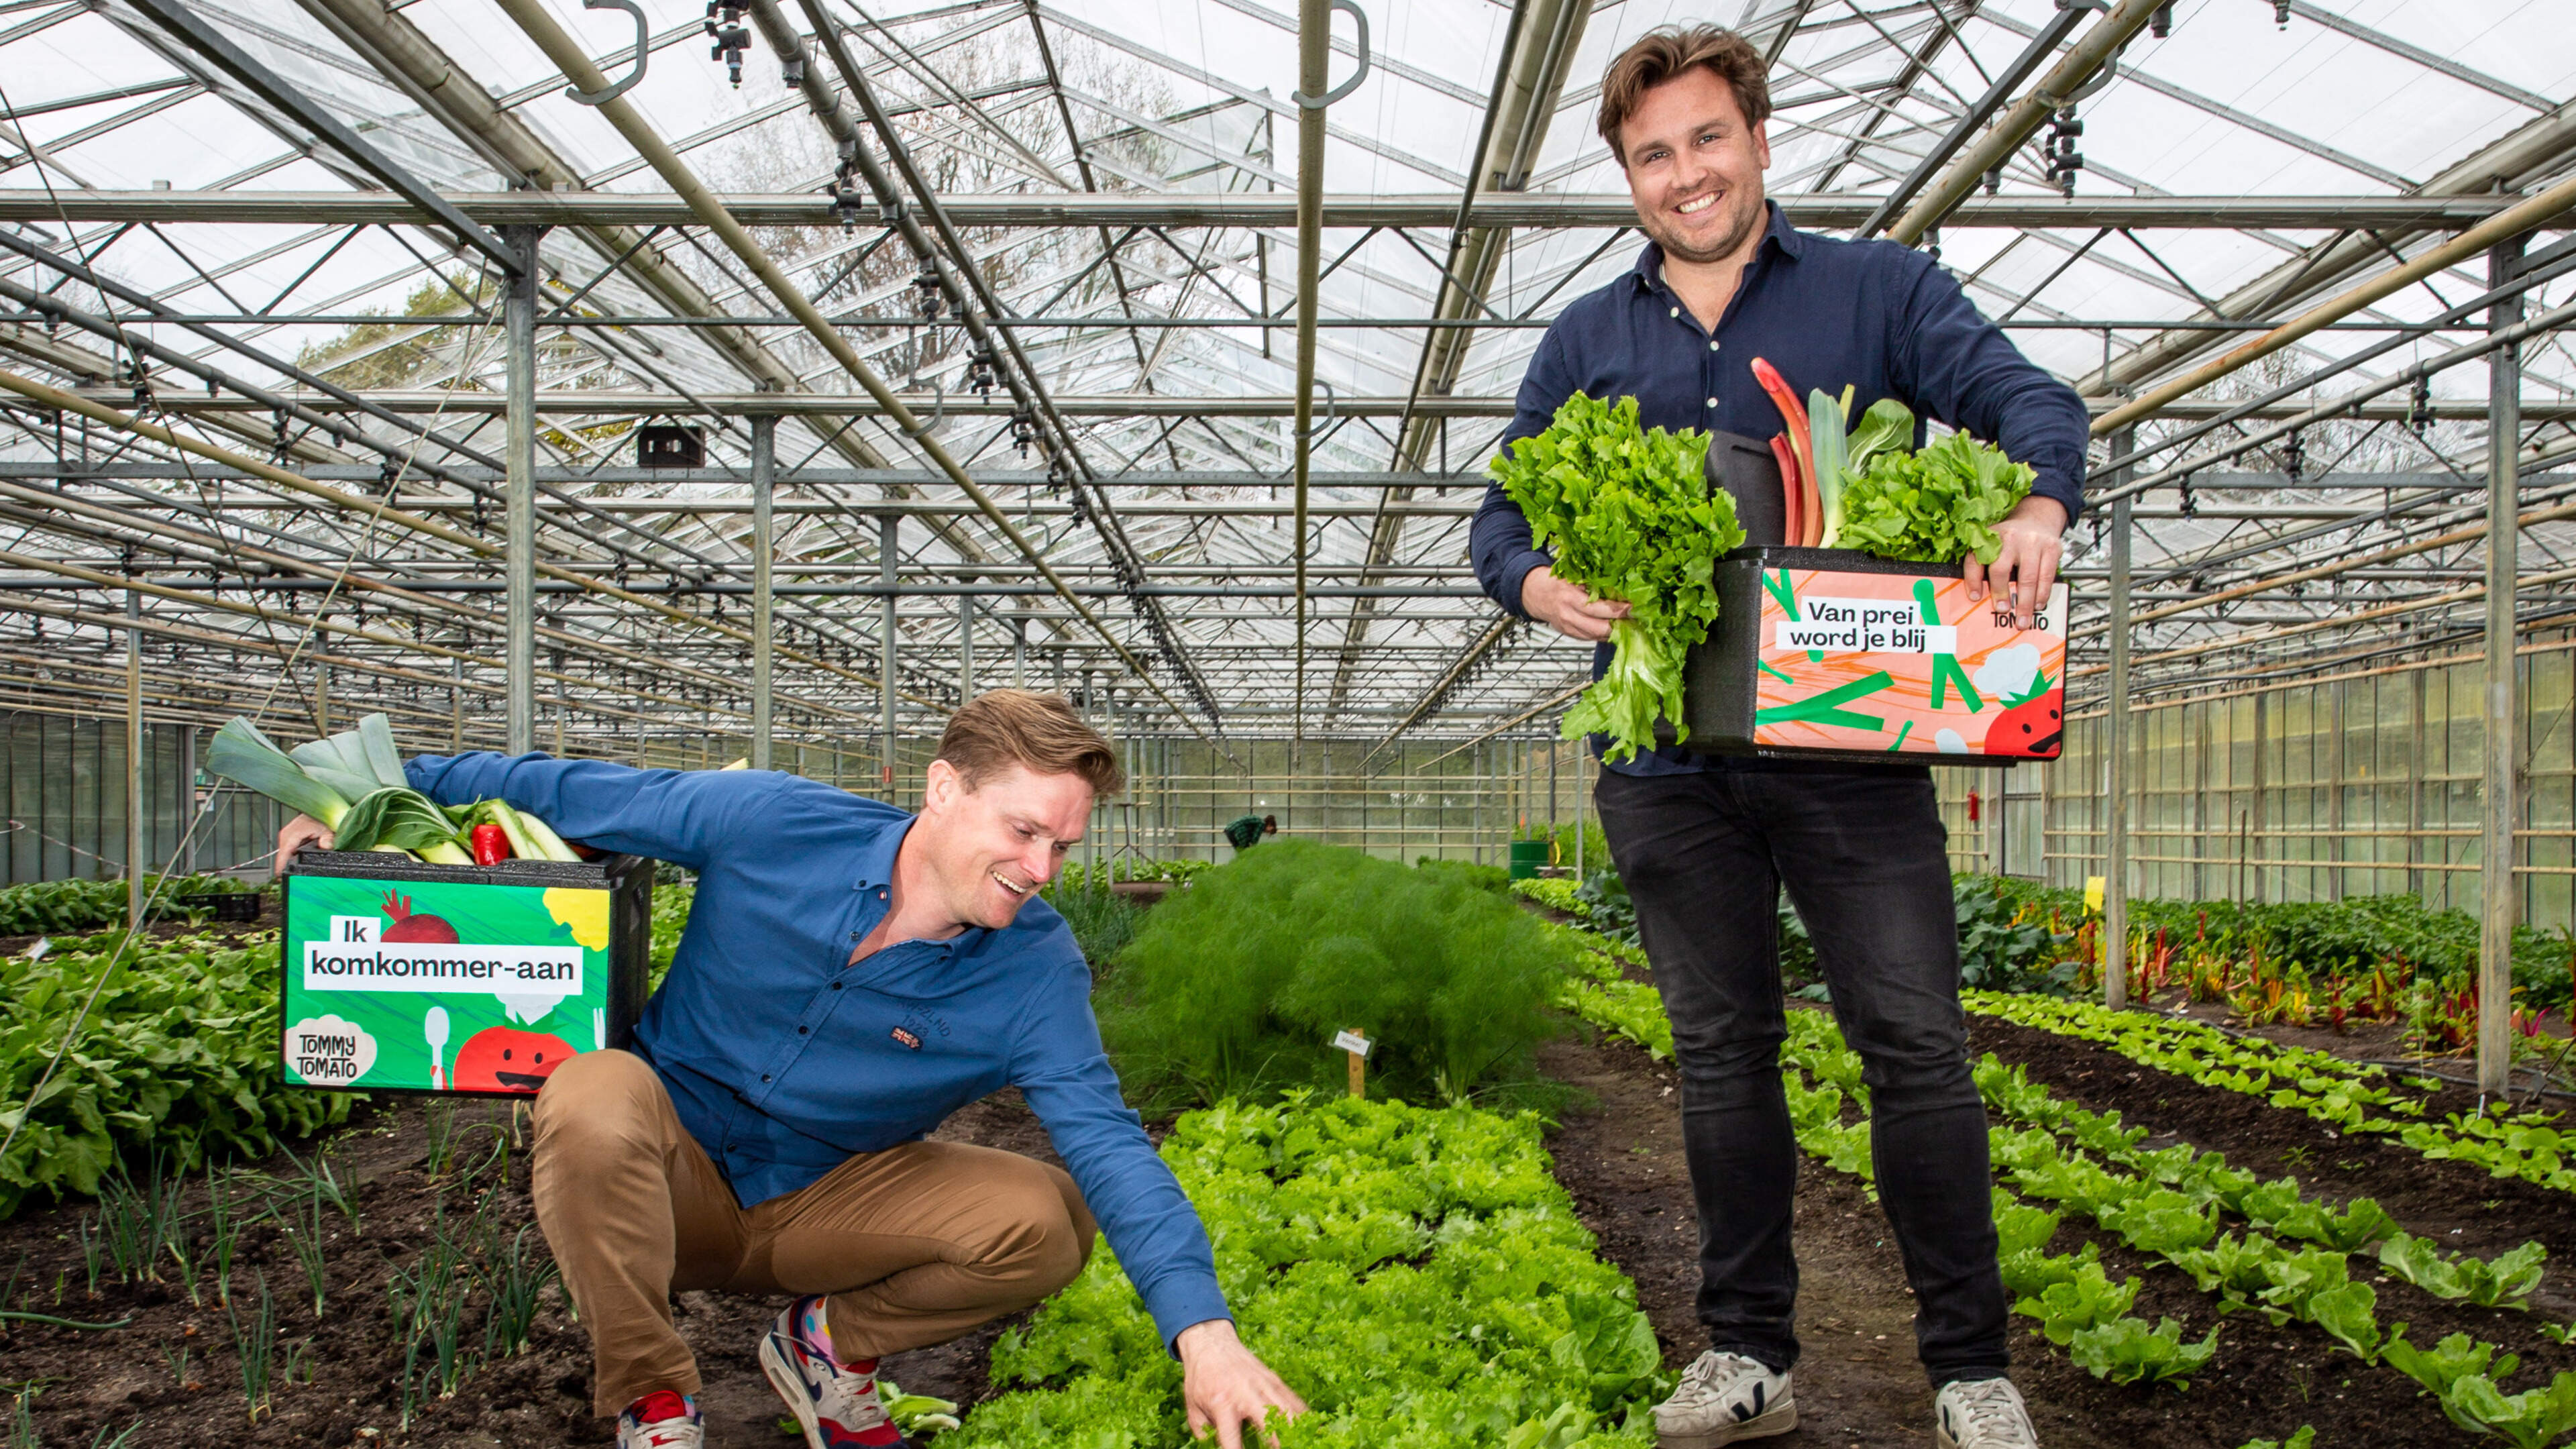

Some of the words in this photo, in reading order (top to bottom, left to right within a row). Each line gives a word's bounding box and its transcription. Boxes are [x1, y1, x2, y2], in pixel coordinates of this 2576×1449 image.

[1808, 602, 1856, 622] Van
[1863, 605, 1914, 628] prei
[1990, 610, 2049, 631] TOMTO
[1790, 628, 1857, 647] word
[1861, 628, 1885, 653] je
[1892, 629, 1926, 653] blij
[344, 920, 366, 943] Ik
[312, 950, 574, 981] komkommer-aan
[299, 1034, 356, 1057] TOMMY
[297, 1057, 357, 1079] TOMATO
